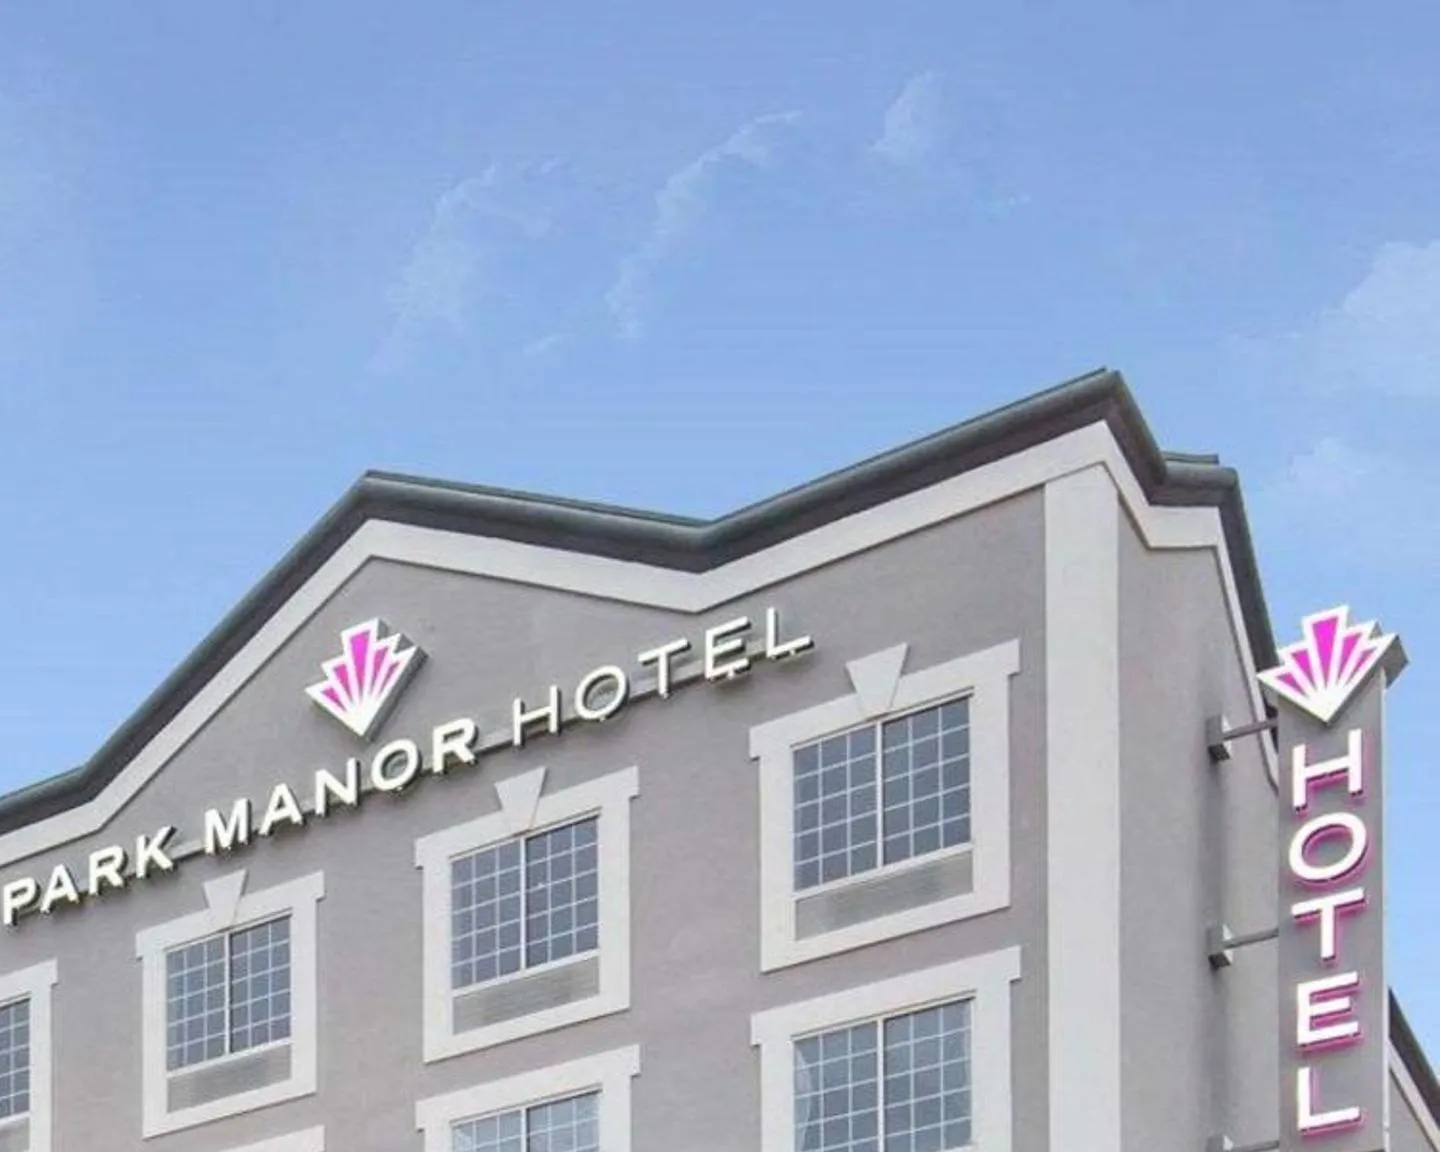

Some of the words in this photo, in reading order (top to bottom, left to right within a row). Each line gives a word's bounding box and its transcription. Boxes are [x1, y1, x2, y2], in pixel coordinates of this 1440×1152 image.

[1, 825, 174, 926] PARK
[203, 716, 477, 856] MANOR
[513, 607, 813, 747] HOTEL
[1289, 728, 1368, 1134] HOTEL
